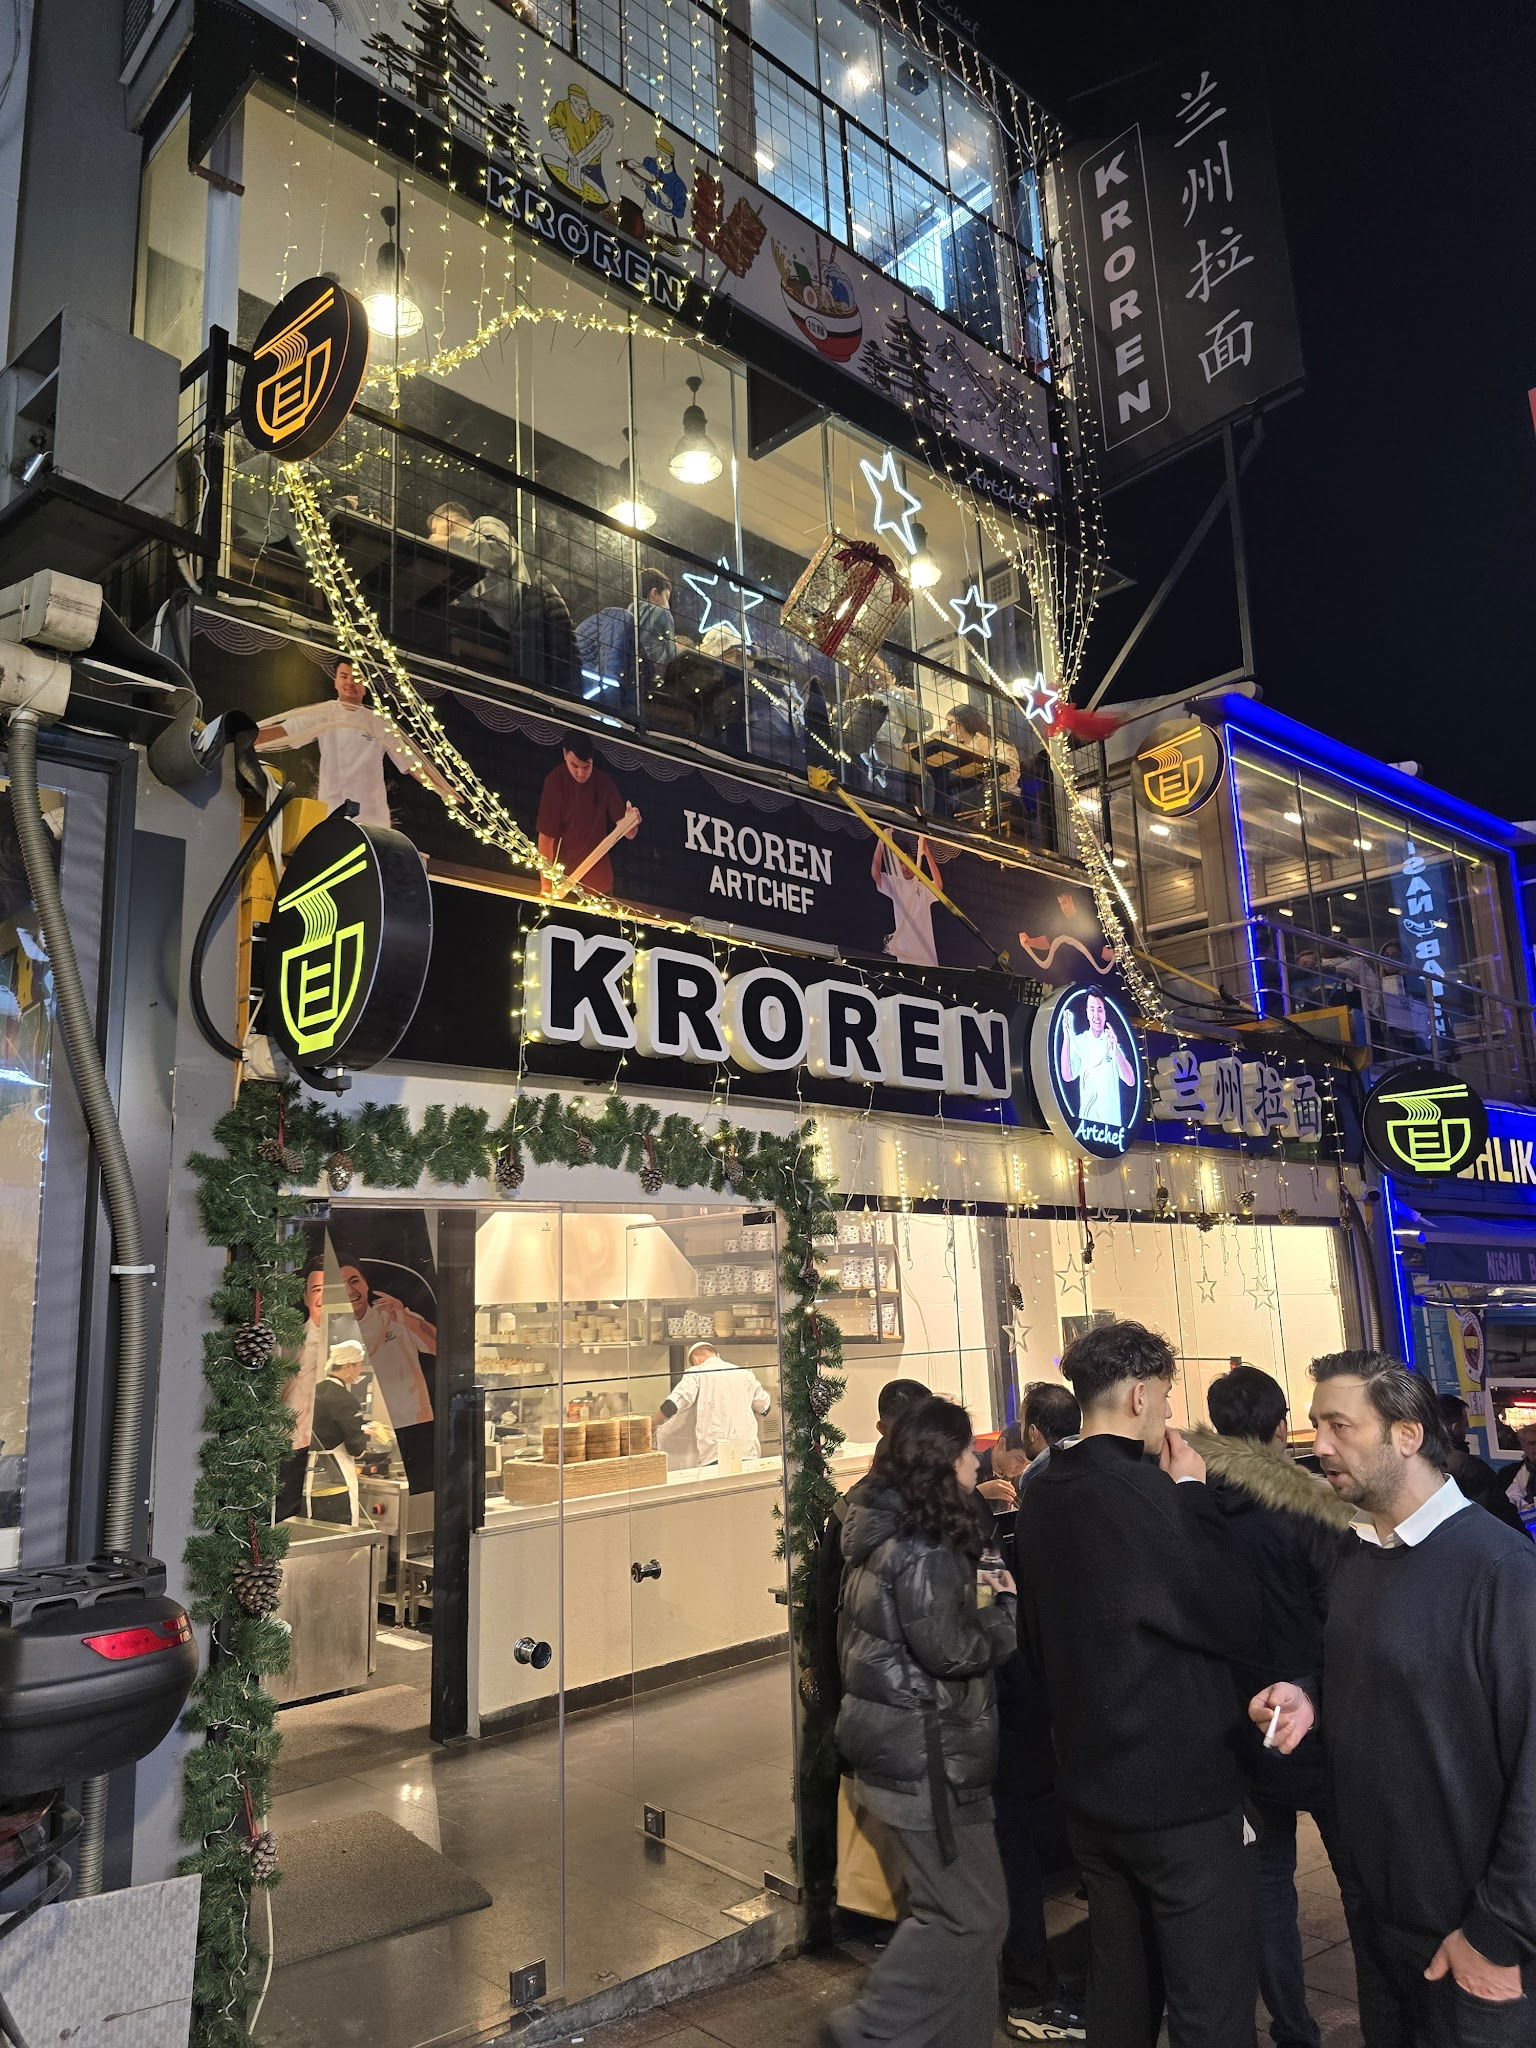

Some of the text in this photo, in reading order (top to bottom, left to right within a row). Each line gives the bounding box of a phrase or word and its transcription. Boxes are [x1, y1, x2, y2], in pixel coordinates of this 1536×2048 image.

[487, 166, 681, 312] KROREN
[1174, 71, 1254, 384] 兰州拉面
[1094, 150, 1151, 424] KROREN
[965, 471, 1035, 510] Artchef
[684, 810, 832, 885] KROREN
[709, 865, 814, 914] ARTCHEF
[530, 924, 1012, 1099] KROREN
[1074, 1120, 1125, 1152] Artchef
[1172, 1053, 1322, 1140] 兰州拉面
[1457, 1137, 1536, 1184] ALIK
